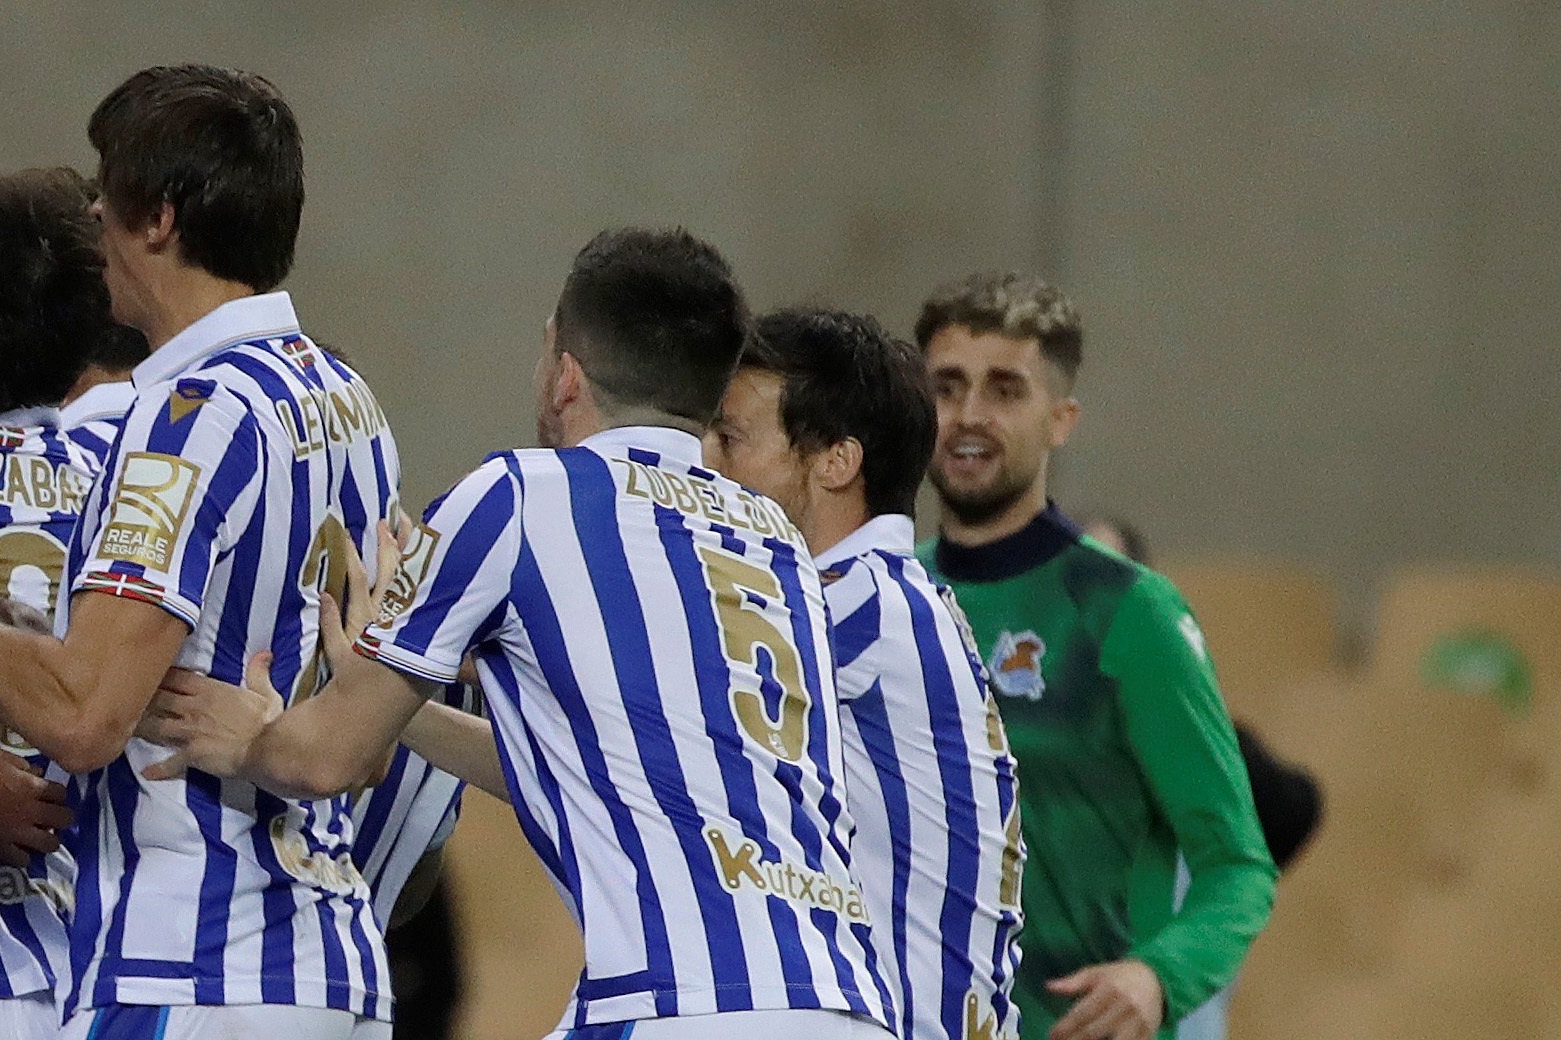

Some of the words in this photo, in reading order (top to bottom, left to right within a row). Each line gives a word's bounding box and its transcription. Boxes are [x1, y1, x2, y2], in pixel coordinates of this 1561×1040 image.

[103, 543, 166, 565] SEGUROS
[106, 528, 169, 555] REALE
[698, 545, 811, 761] 5
